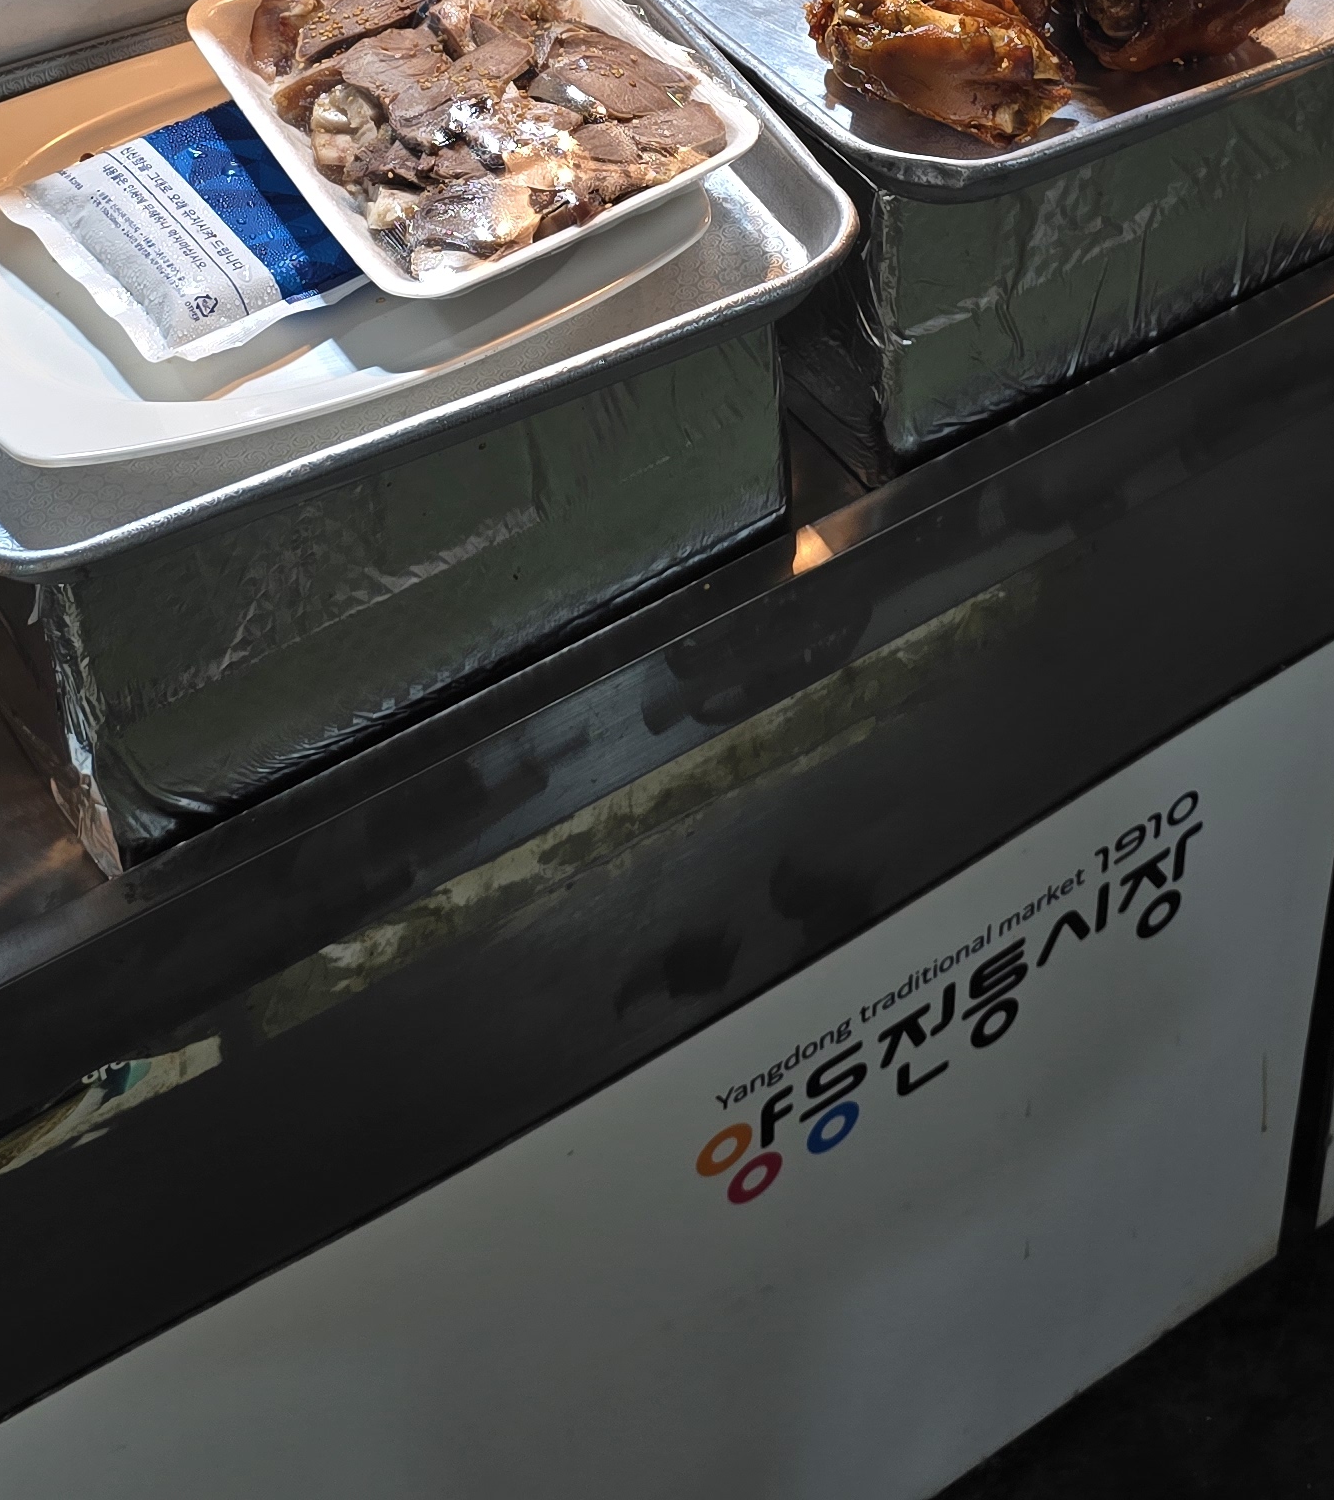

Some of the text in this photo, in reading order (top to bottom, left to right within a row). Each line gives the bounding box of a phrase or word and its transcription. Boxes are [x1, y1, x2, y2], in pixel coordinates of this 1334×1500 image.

[146, 170, 173, 192] 그대로
[170, 192, 188, 211] 오래
[184, 208, 217, 240] 유지시켜
[210, 238, 245, 271] 드립니다
[695, 821, 1204, 1205] 양동전통시장
[715, 789, 1200, 1112] Yangdong traditional market 1910
